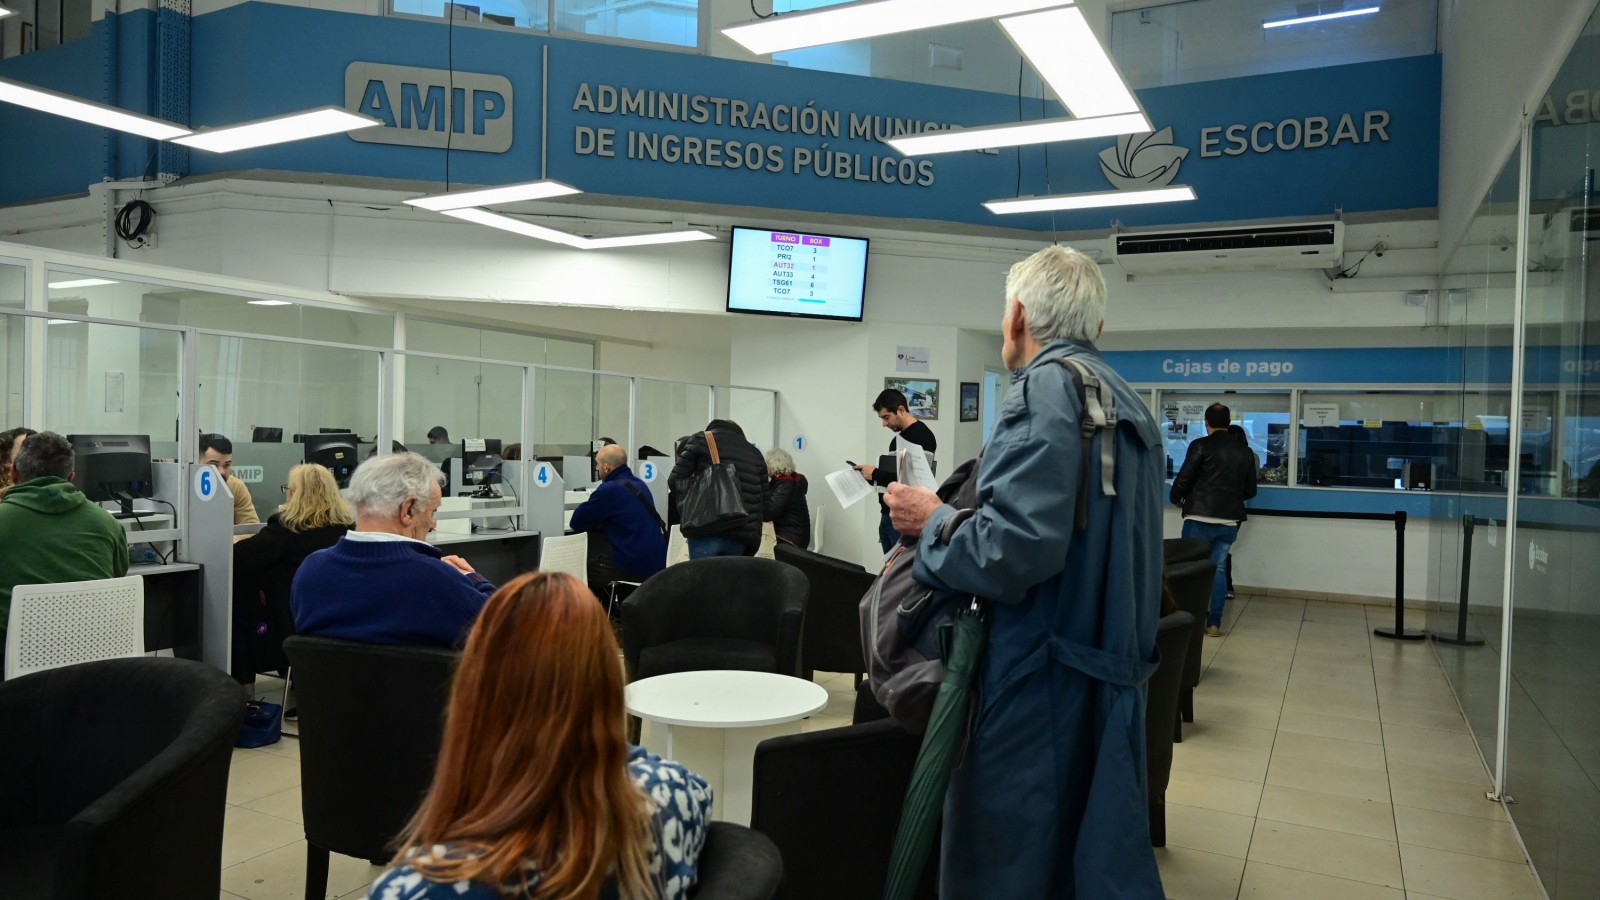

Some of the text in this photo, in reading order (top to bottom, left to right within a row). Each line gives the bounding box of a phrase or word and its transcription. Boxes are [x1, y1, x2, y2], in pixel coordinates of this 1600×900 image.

[358, 79, 505, 136] AMIP
[572, 82, 840, 137] ADMINISTRACIÓN
[1200, 110, 1391, 158] ESCOBAR
[575, 126, 935, 187] DE INGRESOS PÚBLICOS
[1162, 359, 1293, 376] Cajas de pago
[797, 437, 803, 449] 1
[201, 471, 211, 496] 6
[538, 466, 547, 483] 4
[644, 464, 653, 480] 3
